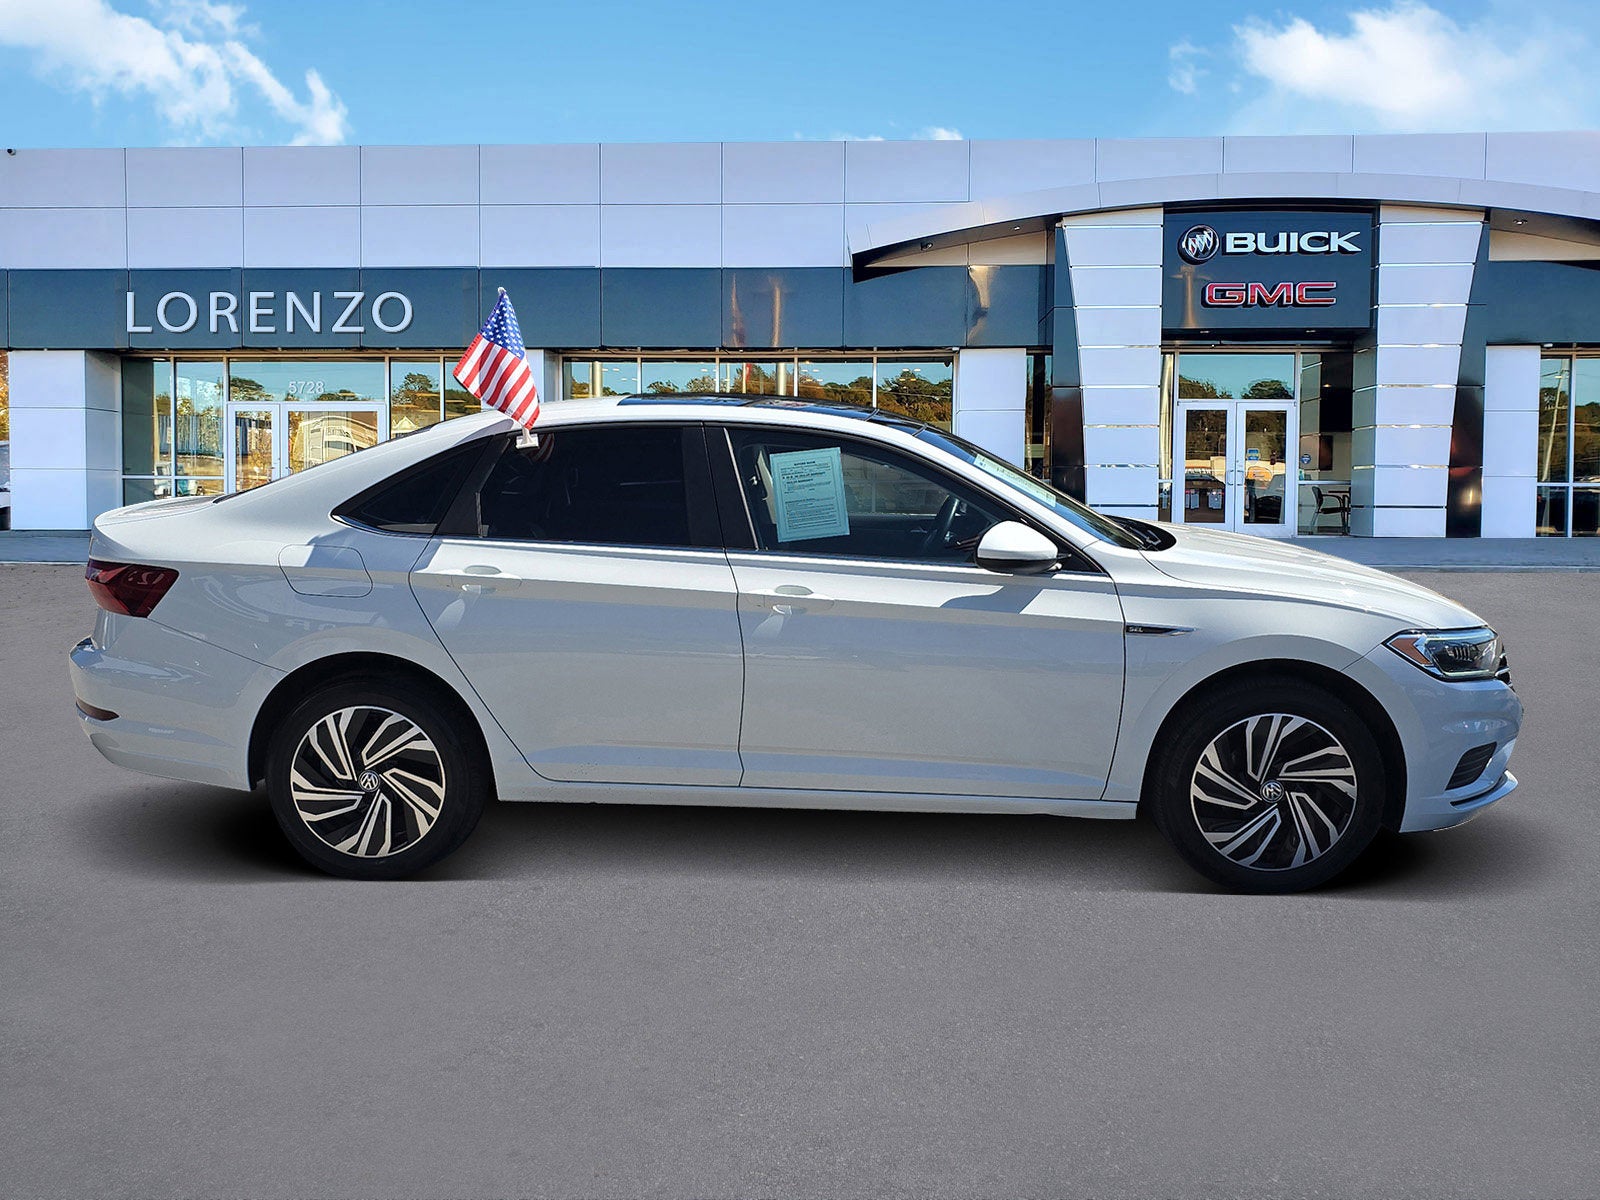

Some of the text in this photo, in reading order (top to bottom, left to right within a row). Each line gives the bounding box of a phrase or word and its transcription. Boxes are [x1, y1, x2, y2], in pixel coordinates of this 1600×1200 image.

[1225, 231, 1362, 253] BUICK
[1205, 281, 1337, 306] GMC
[126, 291, 413, 333] LORENZO
[288, 381, 325, 395] 5728
